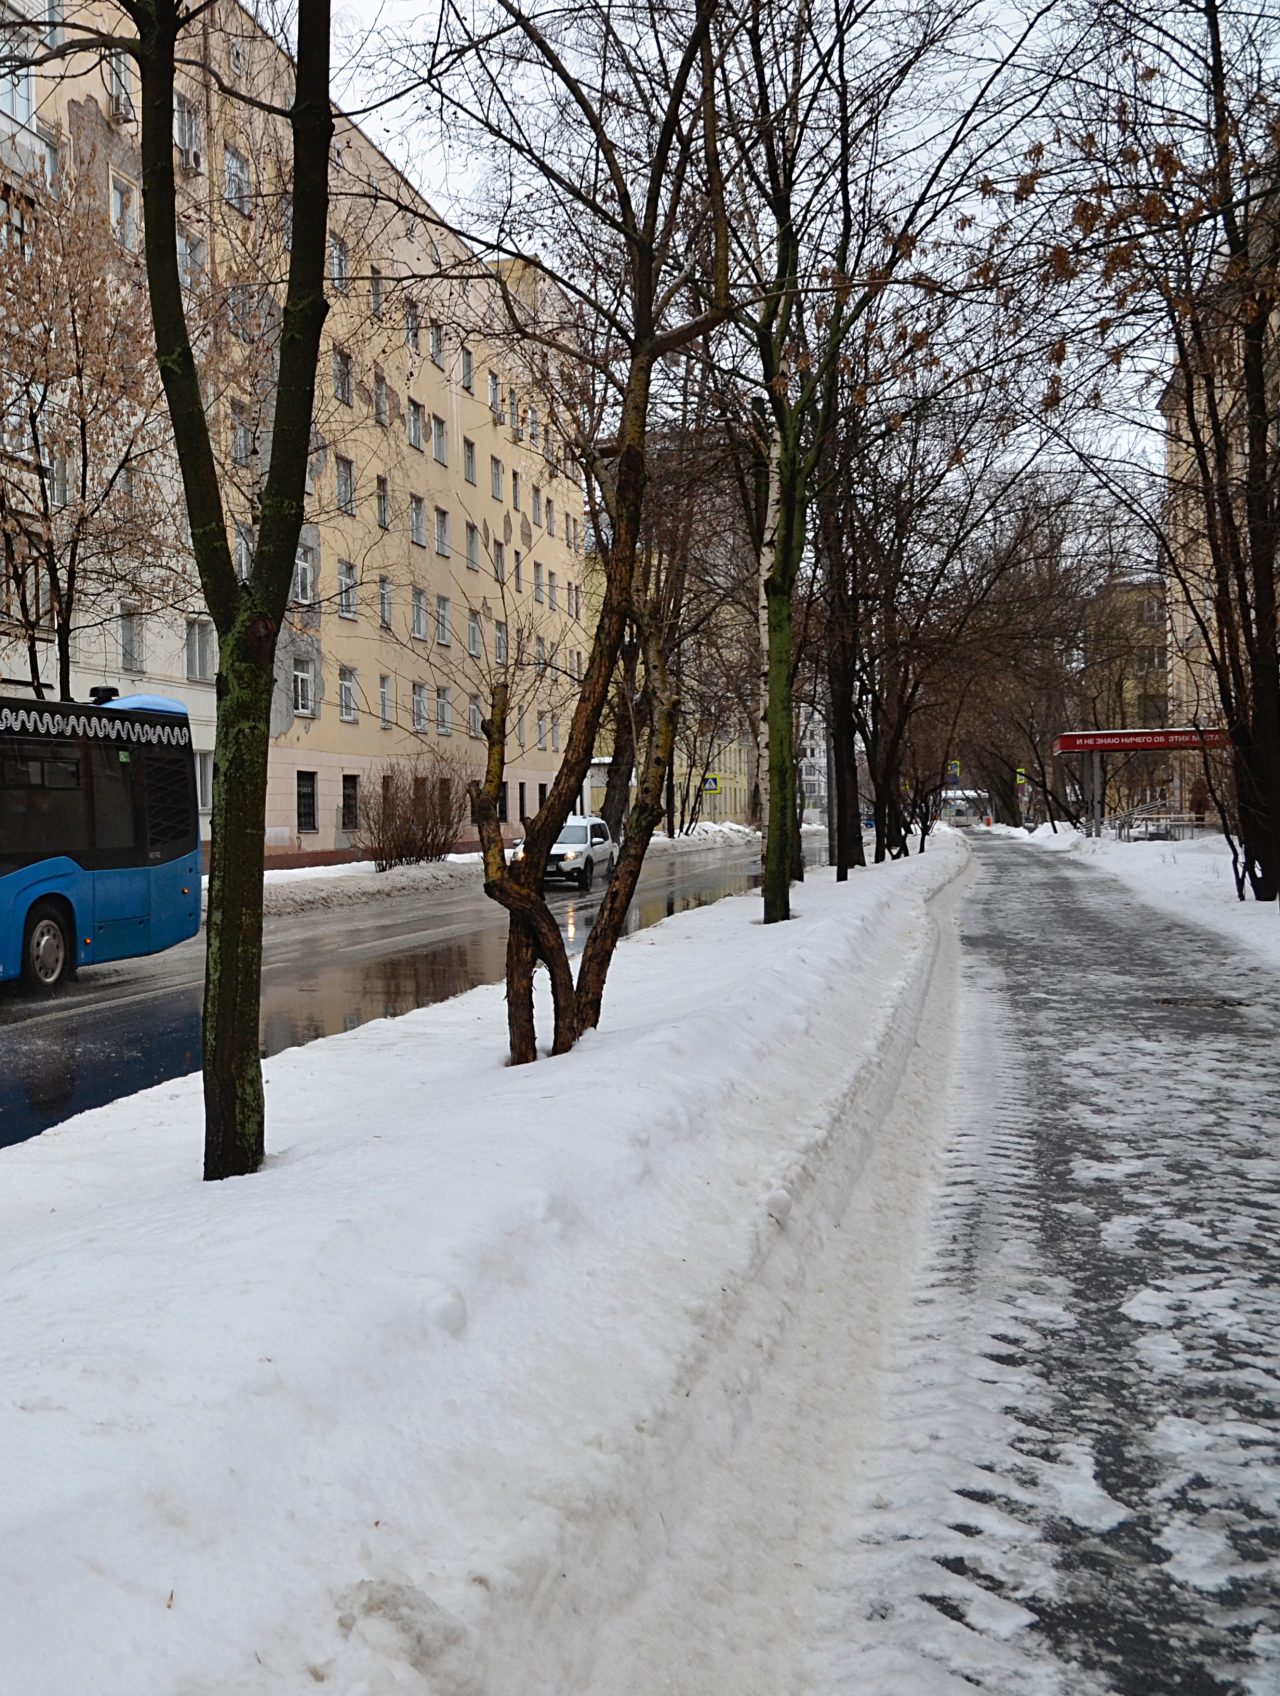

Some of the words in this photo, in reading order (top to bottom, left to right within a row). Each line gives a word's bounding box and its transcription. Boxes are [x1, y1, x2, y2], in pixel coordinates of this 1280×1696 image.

[1096, 736, 1120, 744] ЗНАЮ
[1121, 736, 1153, 744] НИЧЕГО
[1154, 735, 1165, 743] ОБ
[1168, 734, 1190, 742] ЭТИХ
